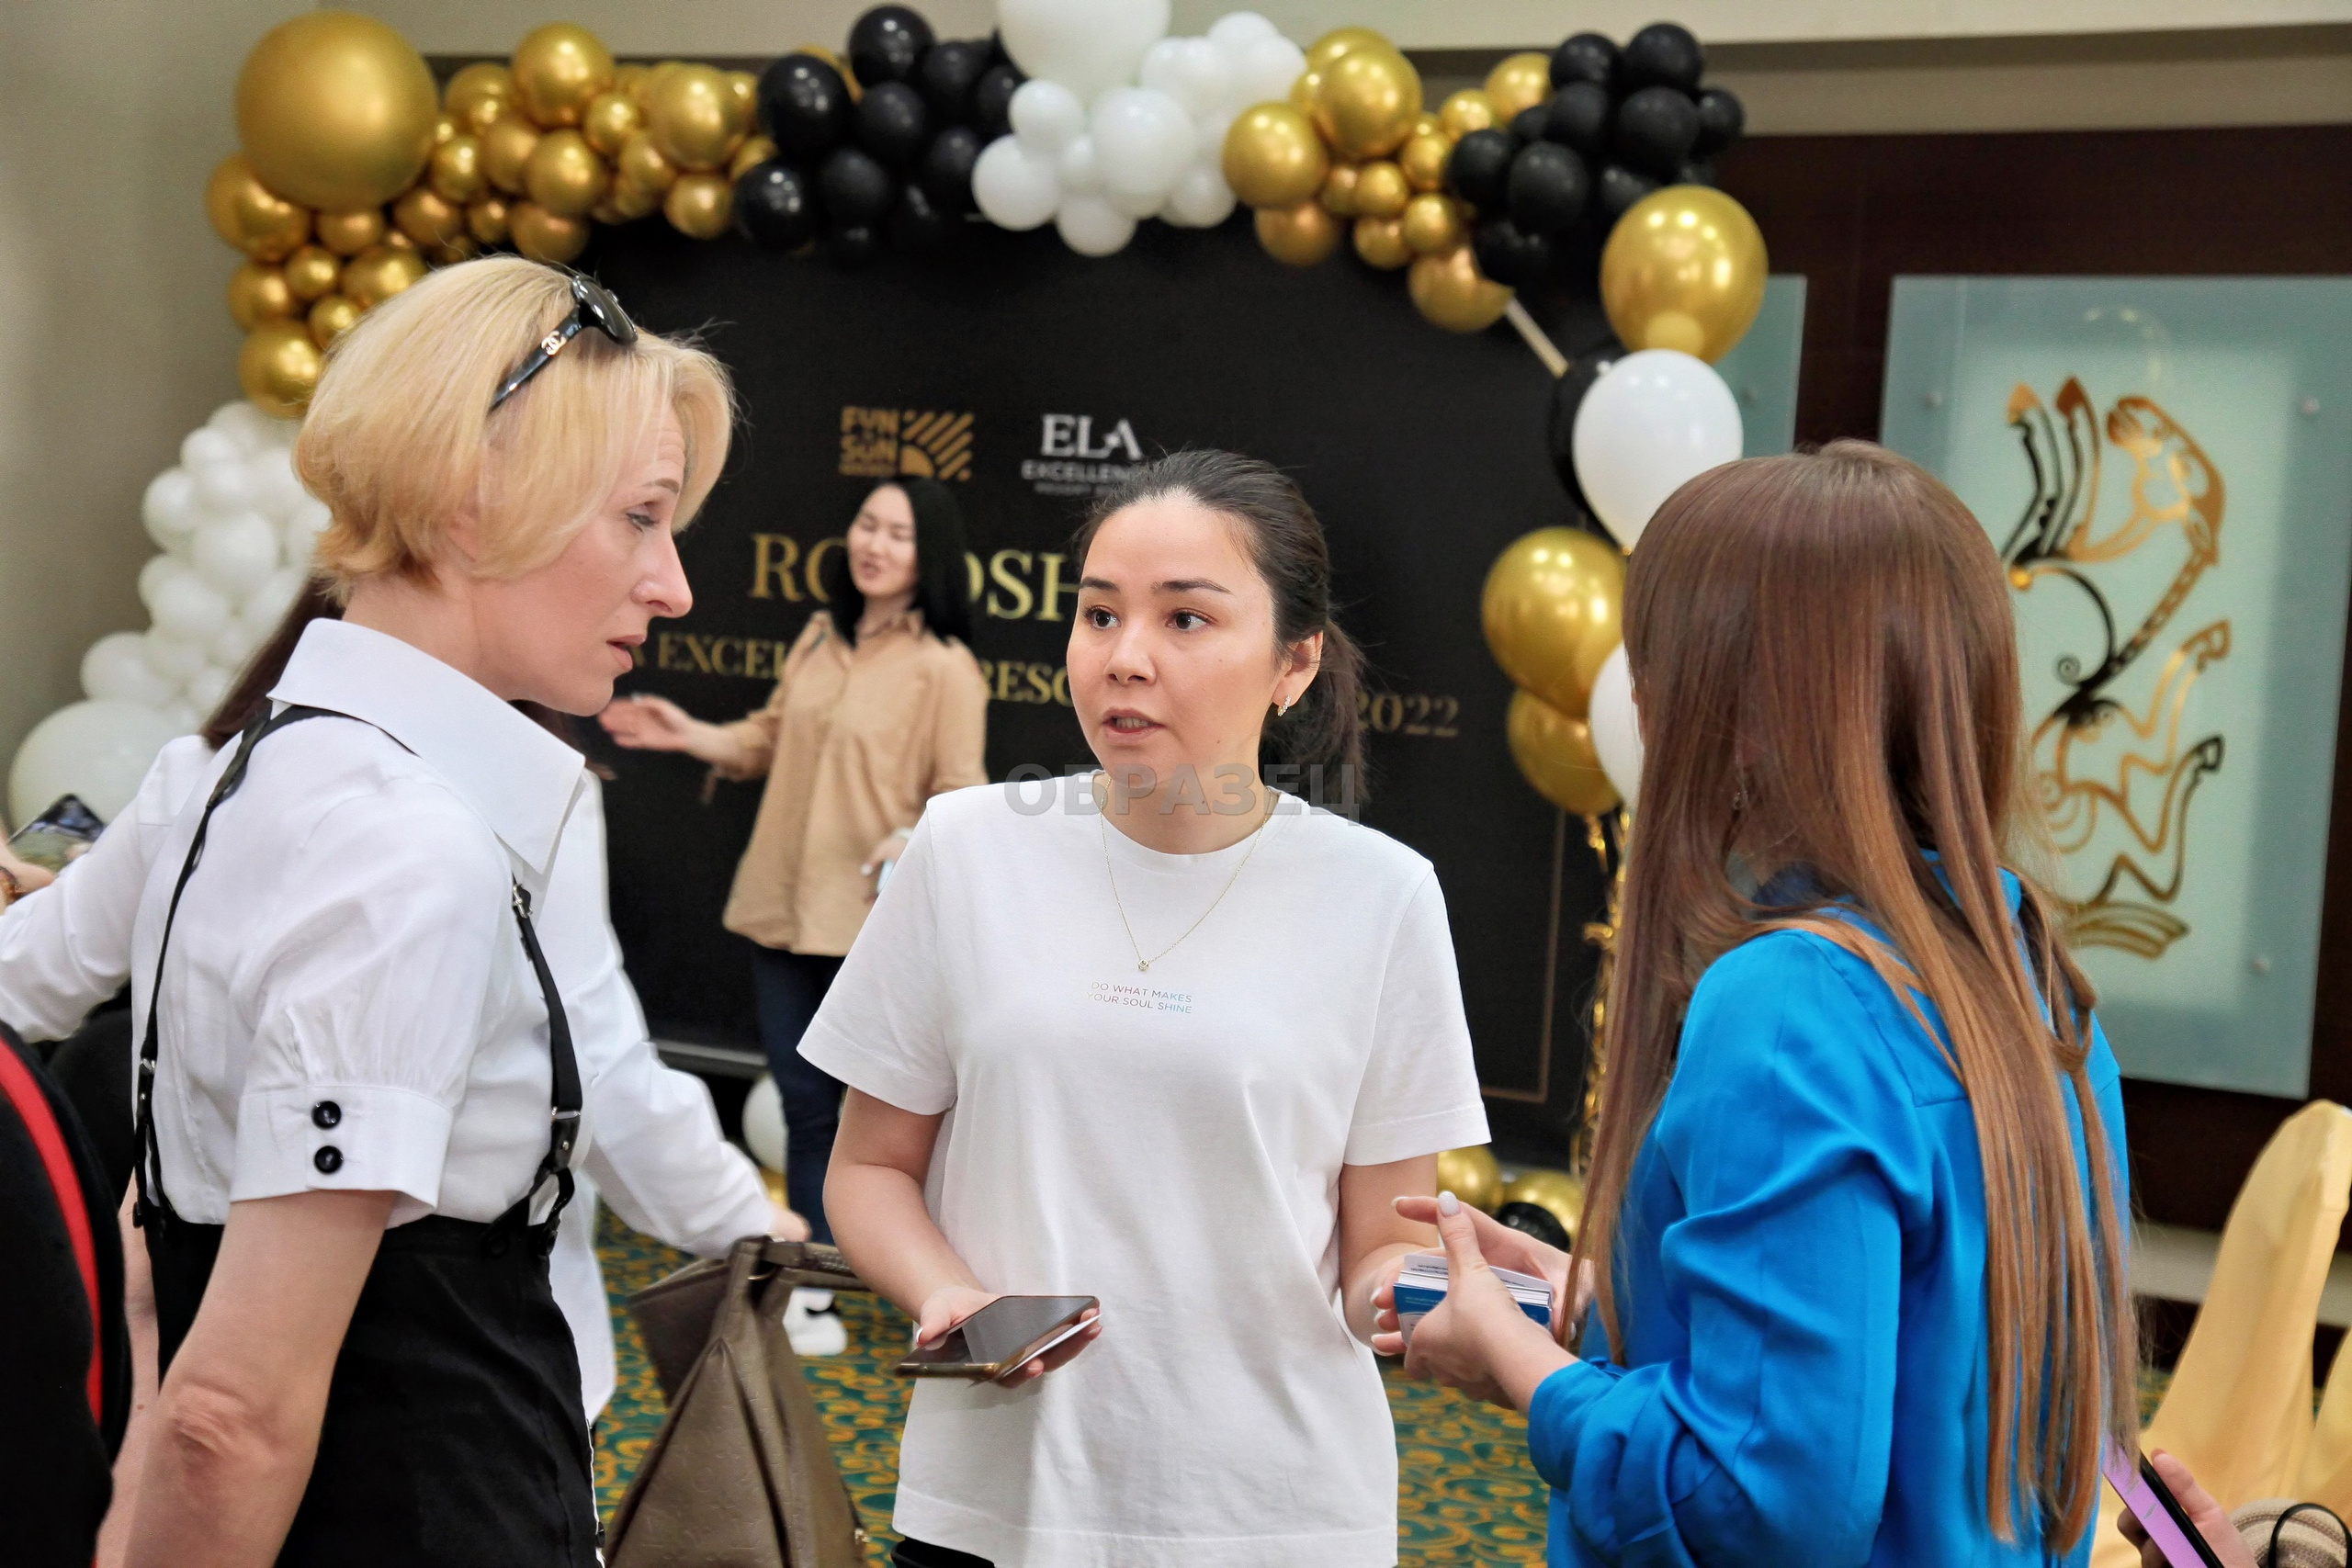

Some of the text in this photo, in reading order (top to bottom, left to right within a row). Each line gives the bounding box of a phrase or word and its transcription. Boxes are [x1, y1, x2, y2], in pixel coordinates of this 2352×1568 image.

[1041, 413, 1143, 459] ELA
[1021, 460, 1129, 483] EXCELLEN
[1086, 991, 1193, 1014] YOUR SOUL SHINE
[1091, 981, 1193, 1003] DO WHAT MAKES
